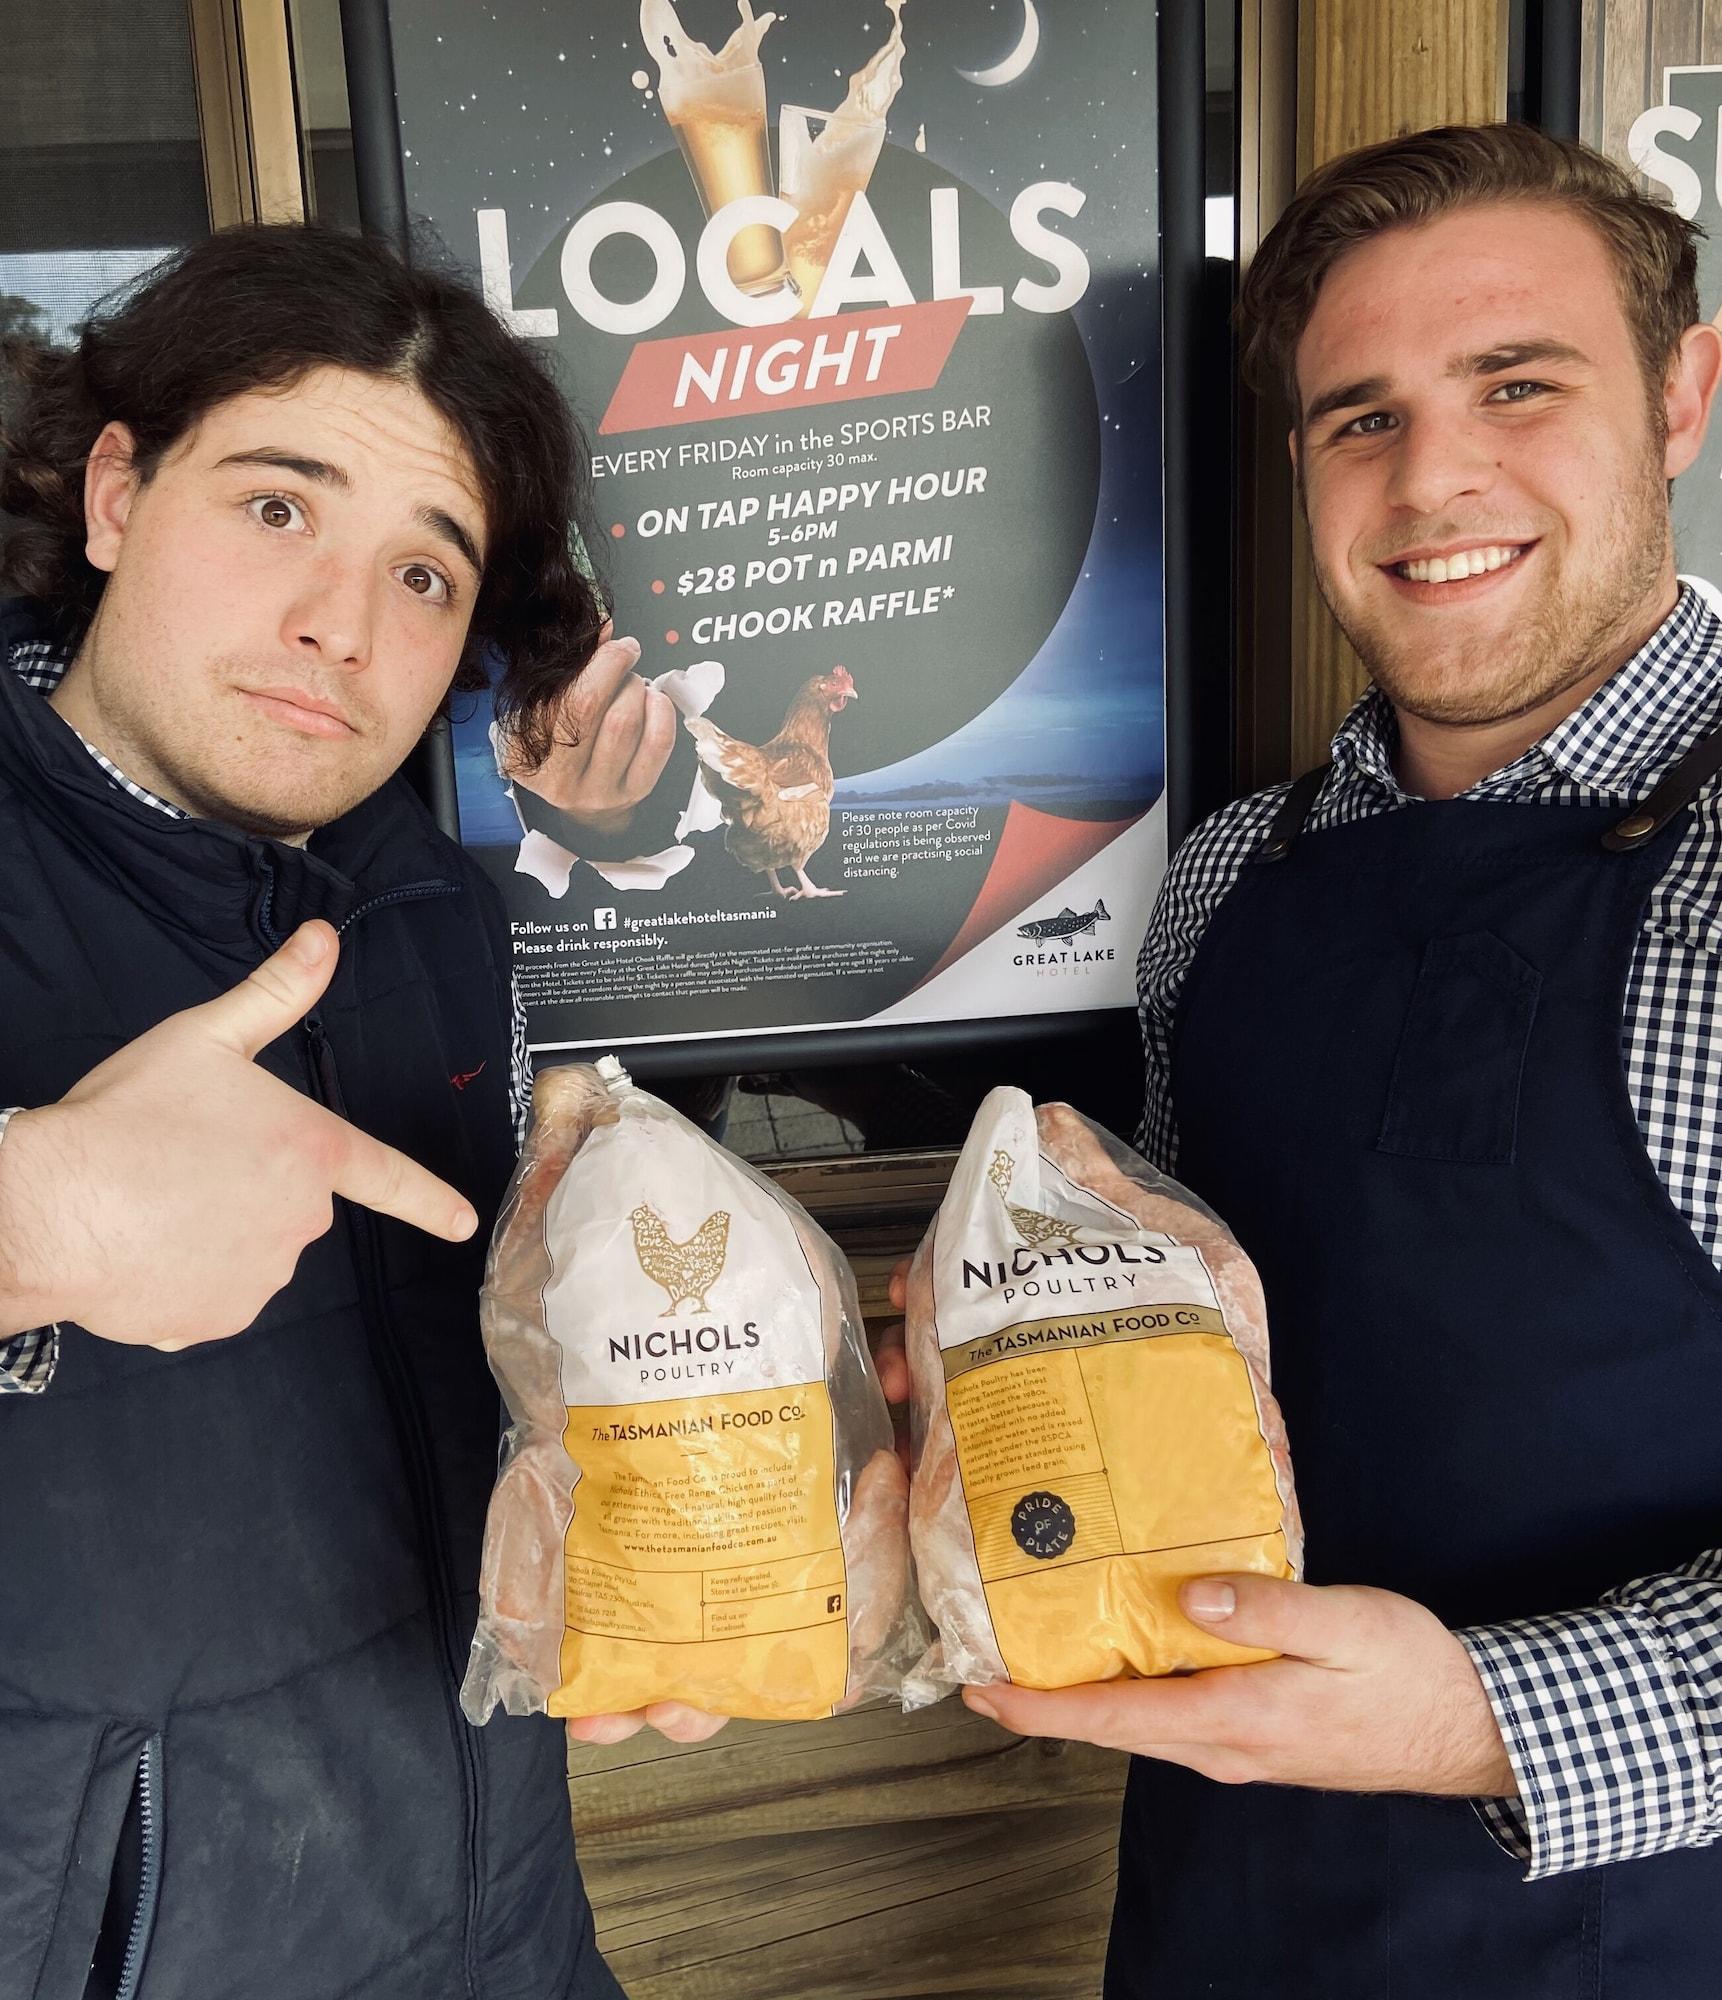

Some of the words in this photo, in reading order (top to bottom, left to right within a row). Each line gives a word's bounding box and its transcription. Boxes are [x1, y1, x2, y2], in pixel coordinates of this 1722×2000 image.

[476, 181, 1090, 336] LOCALS
[673, 323, 901, 407] NIGHT
[591, 447, 672, 478] EVERY
[679, 434, 770, 467] FRIDAY
[775, 433, 794, 454] in
[799, 428, 834, 450] the
[840, 413, 935, 445] SPORTS
[942, 406, 991, 432] BAR
[732, 465, 769, 479] Room
[772, 458, 824, 477] capacity
[827, 453, 844, 467] 30
[848, 452, 877, 465] max.
[637, 506, 689, 538] ON
[697, 497, 760, 529] TAP
[766, 480, 881, 521] HAPPY
[888, 466, 988, 503] HOUR
[768, 520, 838, 546] 5-6PM
[676, 566, 736, 598] $28
[744, 554, 813, 588] POT
[818, 557, 838, 577] n
[847, 534, 953, 574] PARMI
[691, 604, 816, 644] CHOOK
[842, 812, 875, 822] Please
[878, 810, 902, 820] note
[905, 810, 932, 818] room
[935, 804, 979, 820] capacity
[842, 825, 854, 837] of
[856, 824, 871, 836] 30
[875, 823, 909, 837] people
[912, 824, 923, 832] as
[926, 823, 942, 836] per
[945, 818, 976, 830] Covid
[842, 838, 900, 854] regulations
[903, 836, 911, 846] is
[914, 834, 941, 849] being
[944, 830, 991, 843] observed
[843, 853, 862, 864] and
[865, 854, 879, 862] we
[882, 852, 899, 861] are
[902, 848, 952, 864] practising
[955, 844, 983, 856] social
[844, 865, 899, 879] distancing.
[511, 921, 551, 935] Follow
[555, 923, 569, 932] us
[572, 923, 588, 931] on
[623, 906, 777, 932] #greatlakehoteltasmania
[513, 941, 553, 954] Please
[556, 937, 590, 952] drink
[594, 933, 668, 952] responsibly.
[1013, 952, 1068, 966] GREAT
[1074, 949, 1114, 962] LAKE
[1037, 966, 1090, 976] HOTEL
[1004, 1274, 1135, 1303] POULTRY
[609, 1322, 760, 1362] NICHOLS
[969, 1348, 992, 1361] The
[993, 1321, 1106, 1352] TASMANIAN
[1112, 1314, 1169, 1332] FOOD
[640, 1361, 734, 1383] POULTRY
[592, 1428, 609, 1441] The
[610, 1416, 713, 1441] TASMANIAN
[721, 1410, 772, 1430] FOOD
[1041, 1431, 1072, 1442] RSPCA
[665, 1491, 685, 1500] Free
[689, 1489, 715, 1497] Range
[719, 1483, 753, 1495] Chicken
[768, 1477, 785, 1488] part
[789, 1475, 796, 1483] of
[667, 1476, 690, 1485] Food
[721, 1468, 747, 1482] proud
[612, 1501, 648, 1512] extensive
[652, 1506, 676, 1515] range
[728, 1497, 745, 1508] high
[749, 1492, 777, 1505] quality
[1018, 1498, 1062, 1520] PRIDE
[614, 1516, 638, 1524] grown
[642, 1517, 660, 1525] with
[664, 1515, 709, 1526] traditional
[739, 1509, 753, 1519] and
[757, 1505, 786, 1519] passion
[1035, 1519, 1051, 1530] OF
[635, 1531, 649, 1539] For
[683, 1530, 723, 1539] including
[727, 1524, 749, 1537] great
[1026, 1531, 1068, 1553] PLATE
[624, 1536, 777, 1552] www.thetasmanianfoodco.com.au
